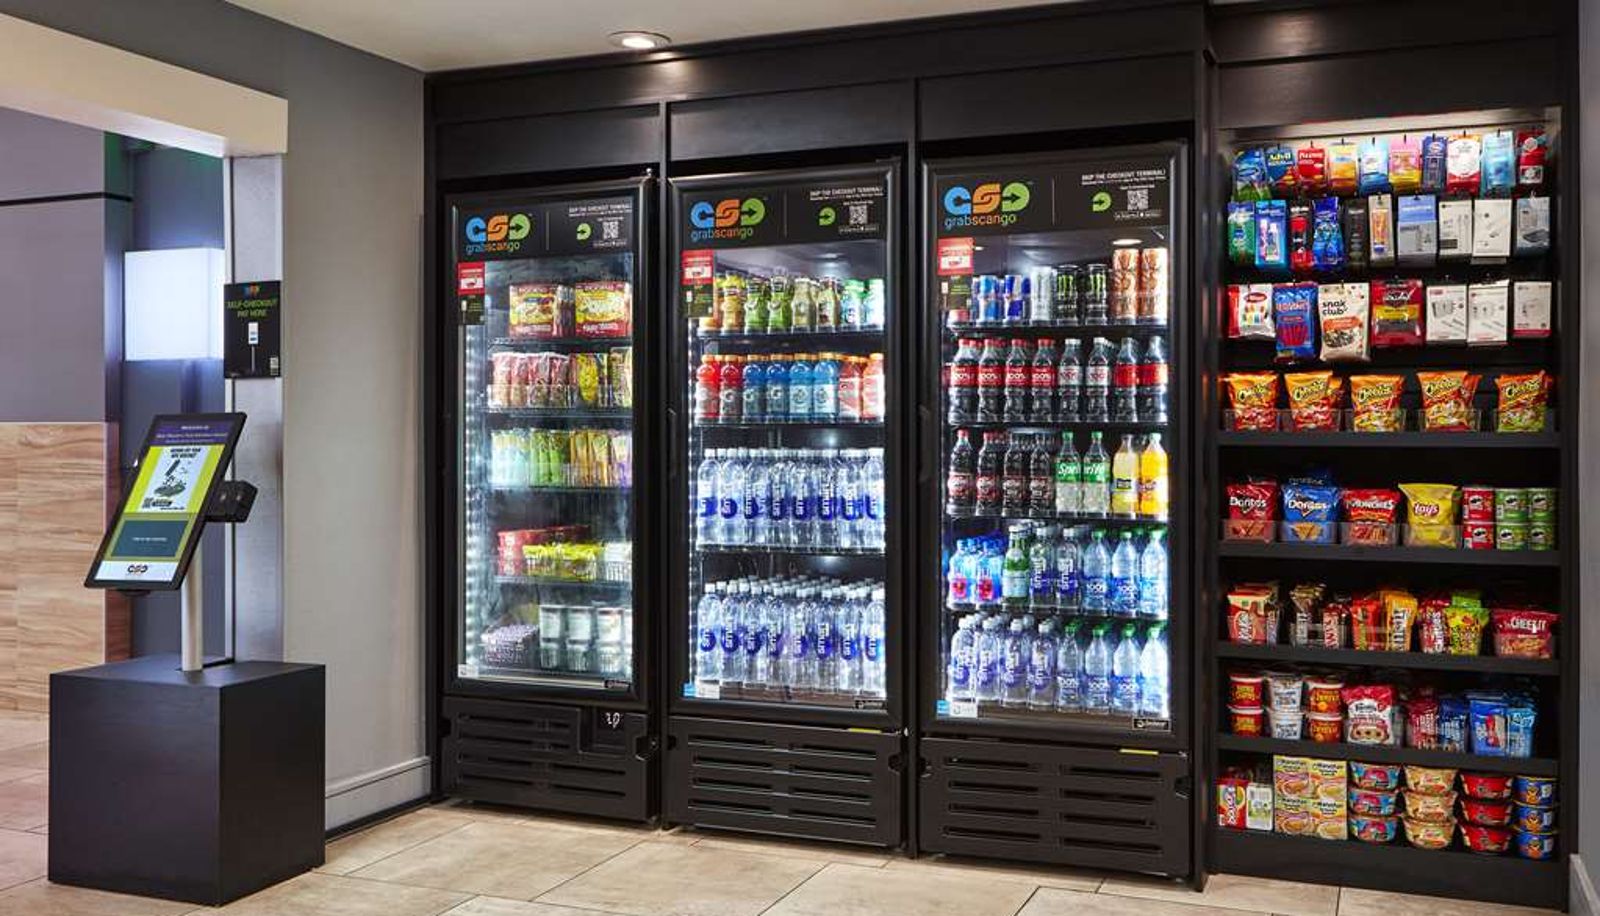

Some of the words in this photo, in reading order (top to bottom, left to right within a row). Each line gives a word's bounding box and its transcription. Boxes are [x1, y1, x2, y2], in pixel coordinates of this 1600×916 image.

[944, 213, 1017, 230] grabscango
[690, 227, 754, 243] grabscango
[465, 241, 520, 257] grabscango
[1322, 299, 1346, 308] snak
[1322, 307, 1345, 316] club
[1229, 496, 1268, 508] Doritos
[1288, 499, 1329, 510] Doritos
